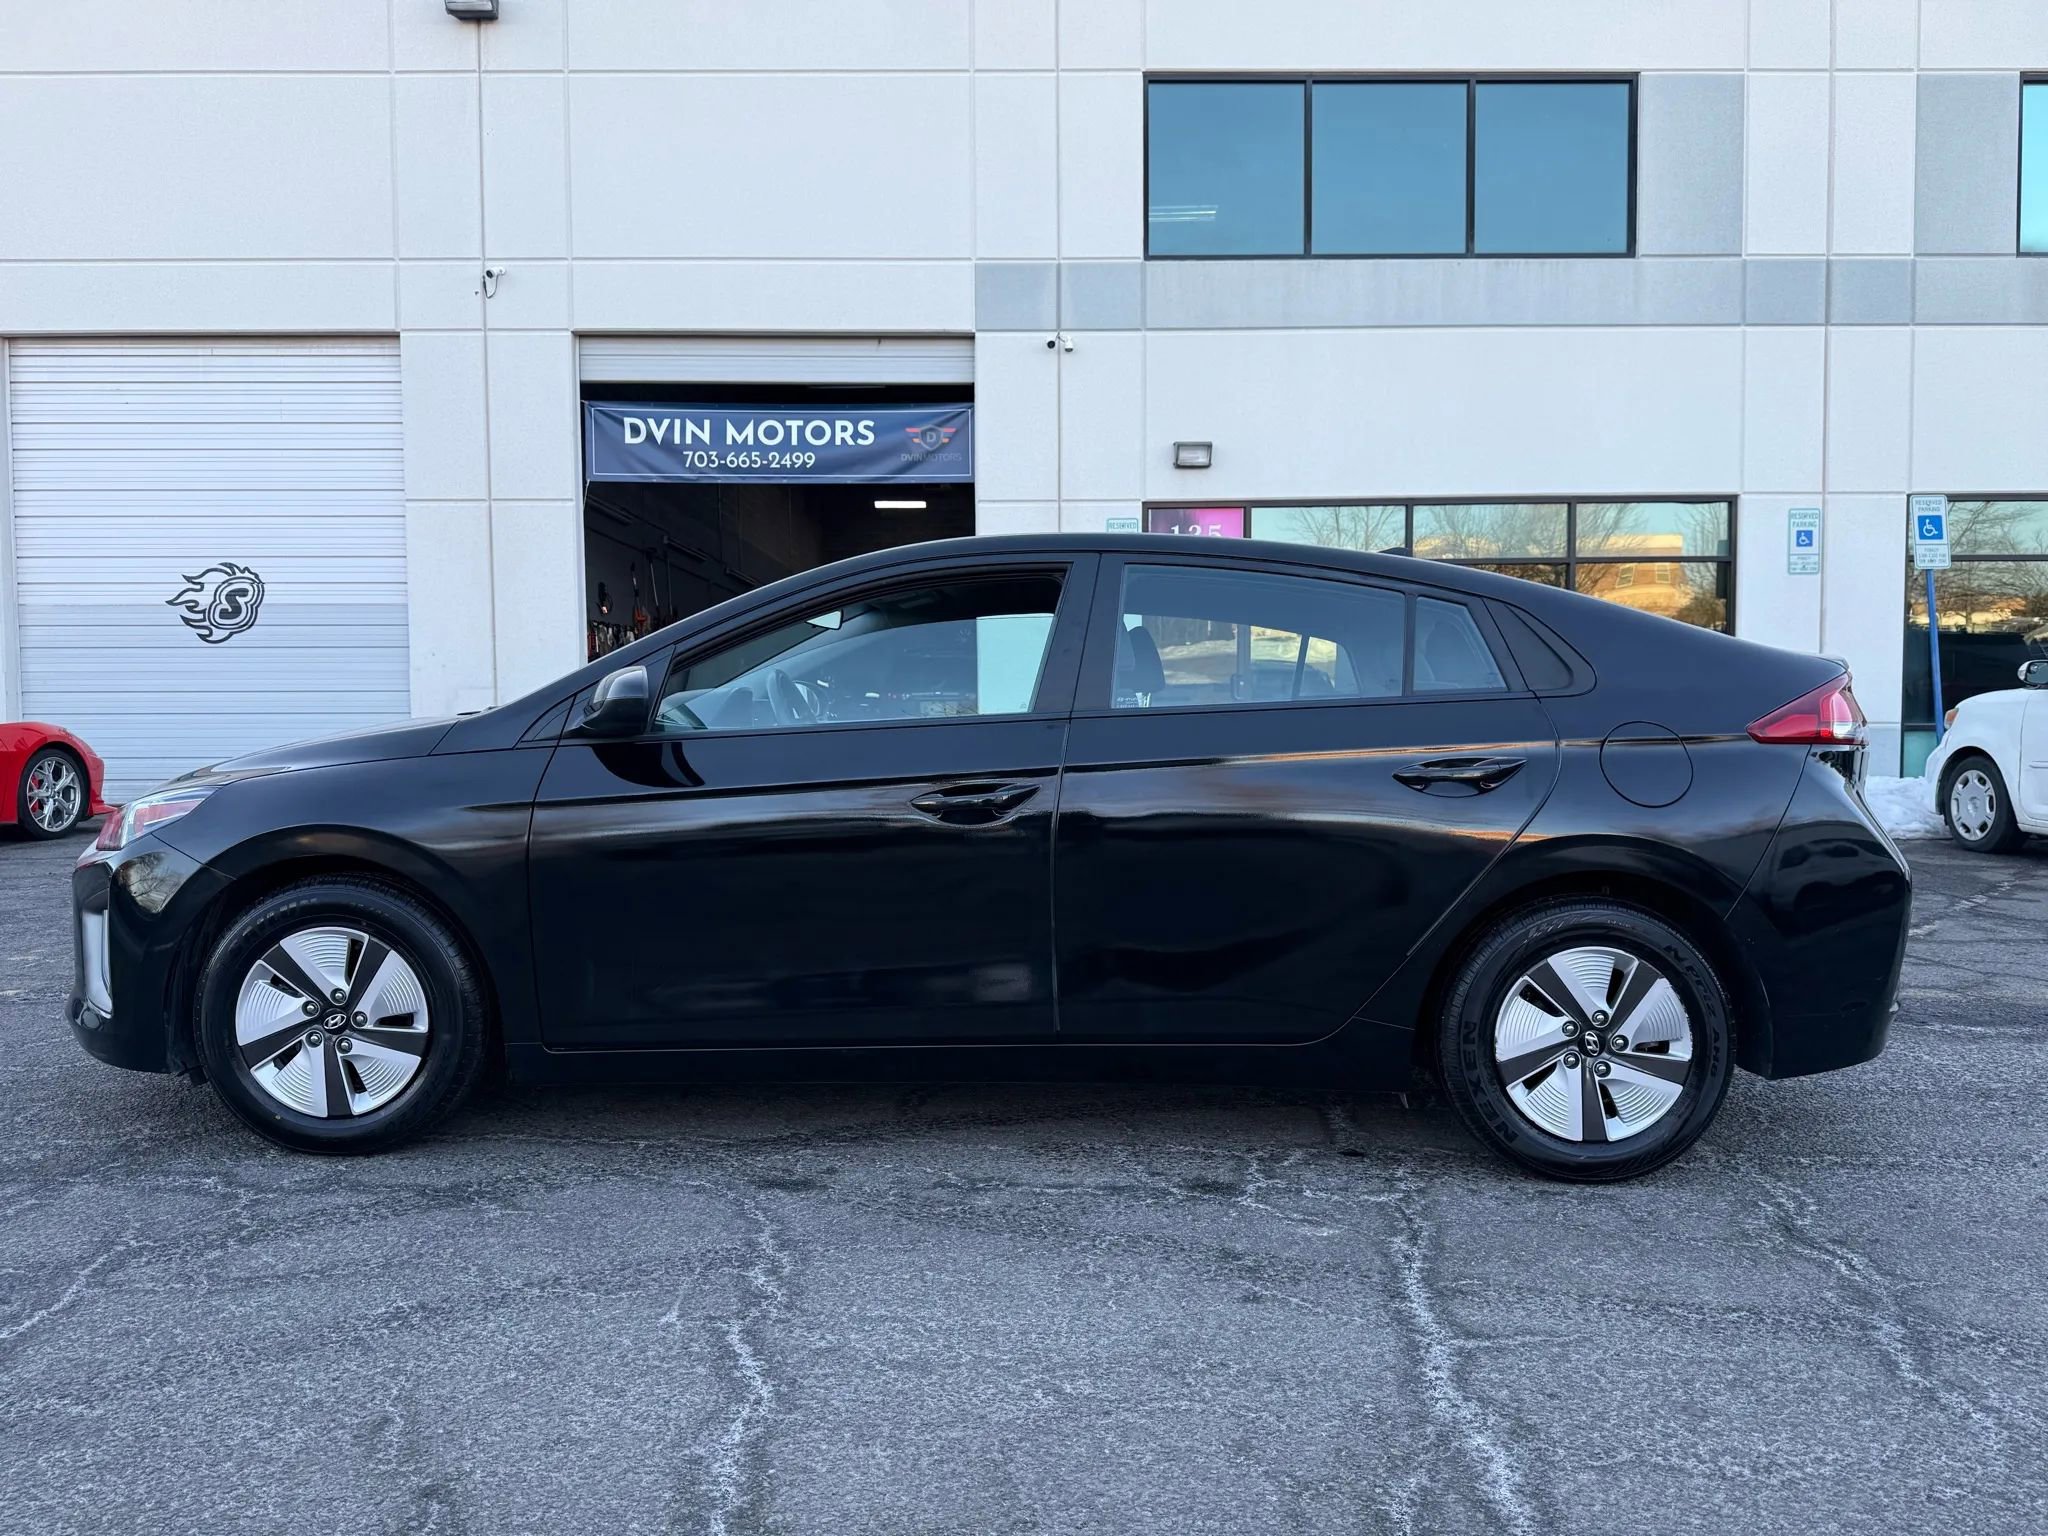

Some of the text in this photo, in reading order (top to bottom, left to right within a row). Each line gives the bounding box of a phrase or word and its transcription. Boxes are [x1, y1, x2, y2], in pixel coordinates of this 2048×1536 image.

[623, 417, 876, 446] DVIN MOTORS
[683, 450, 816, 469] 703-665-2499
[1461, 1021, 1520, 1143] NEXEN
